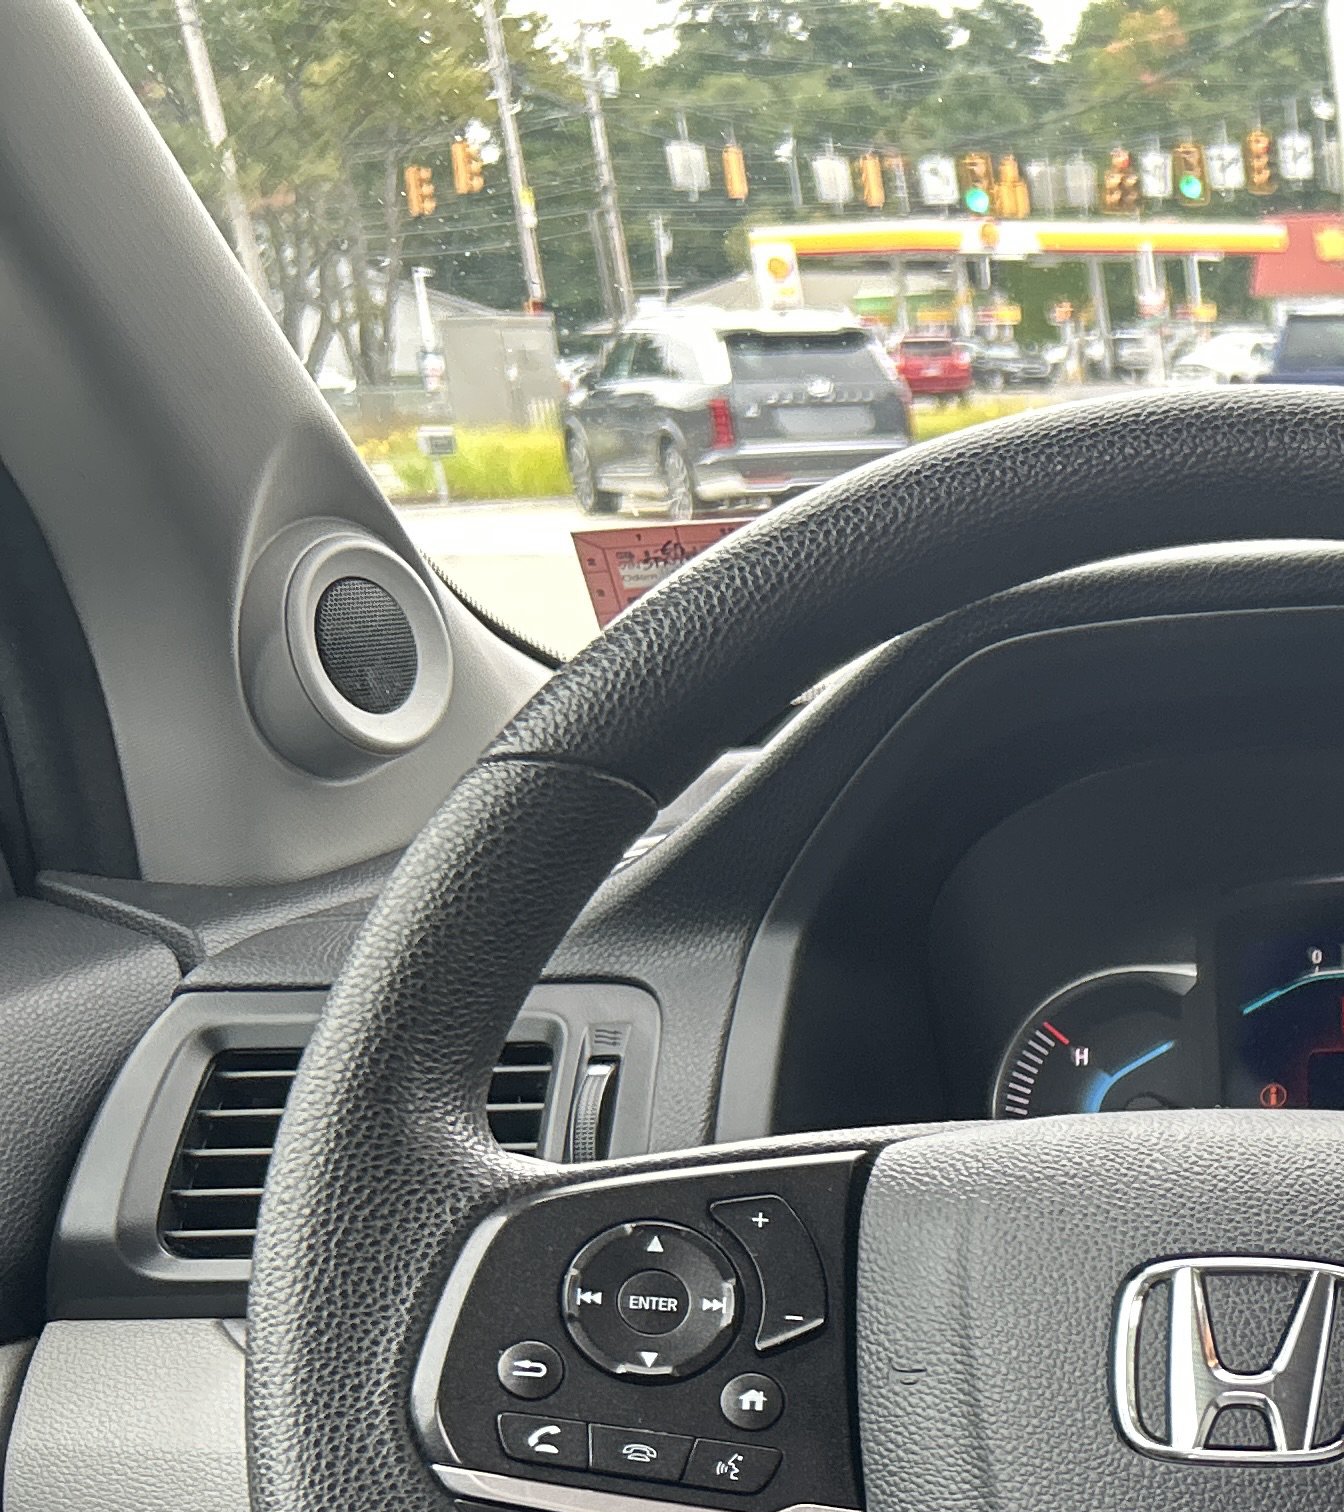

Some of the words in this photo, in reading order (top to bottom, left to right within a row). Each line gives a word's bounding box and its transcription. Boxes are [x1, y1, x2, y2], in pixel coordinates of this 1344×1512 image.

[1311, 949, 1323, 966] 0
[1074, 1047, 1089, 1067] H
[627, 1294, 679, 1313] ENTER
